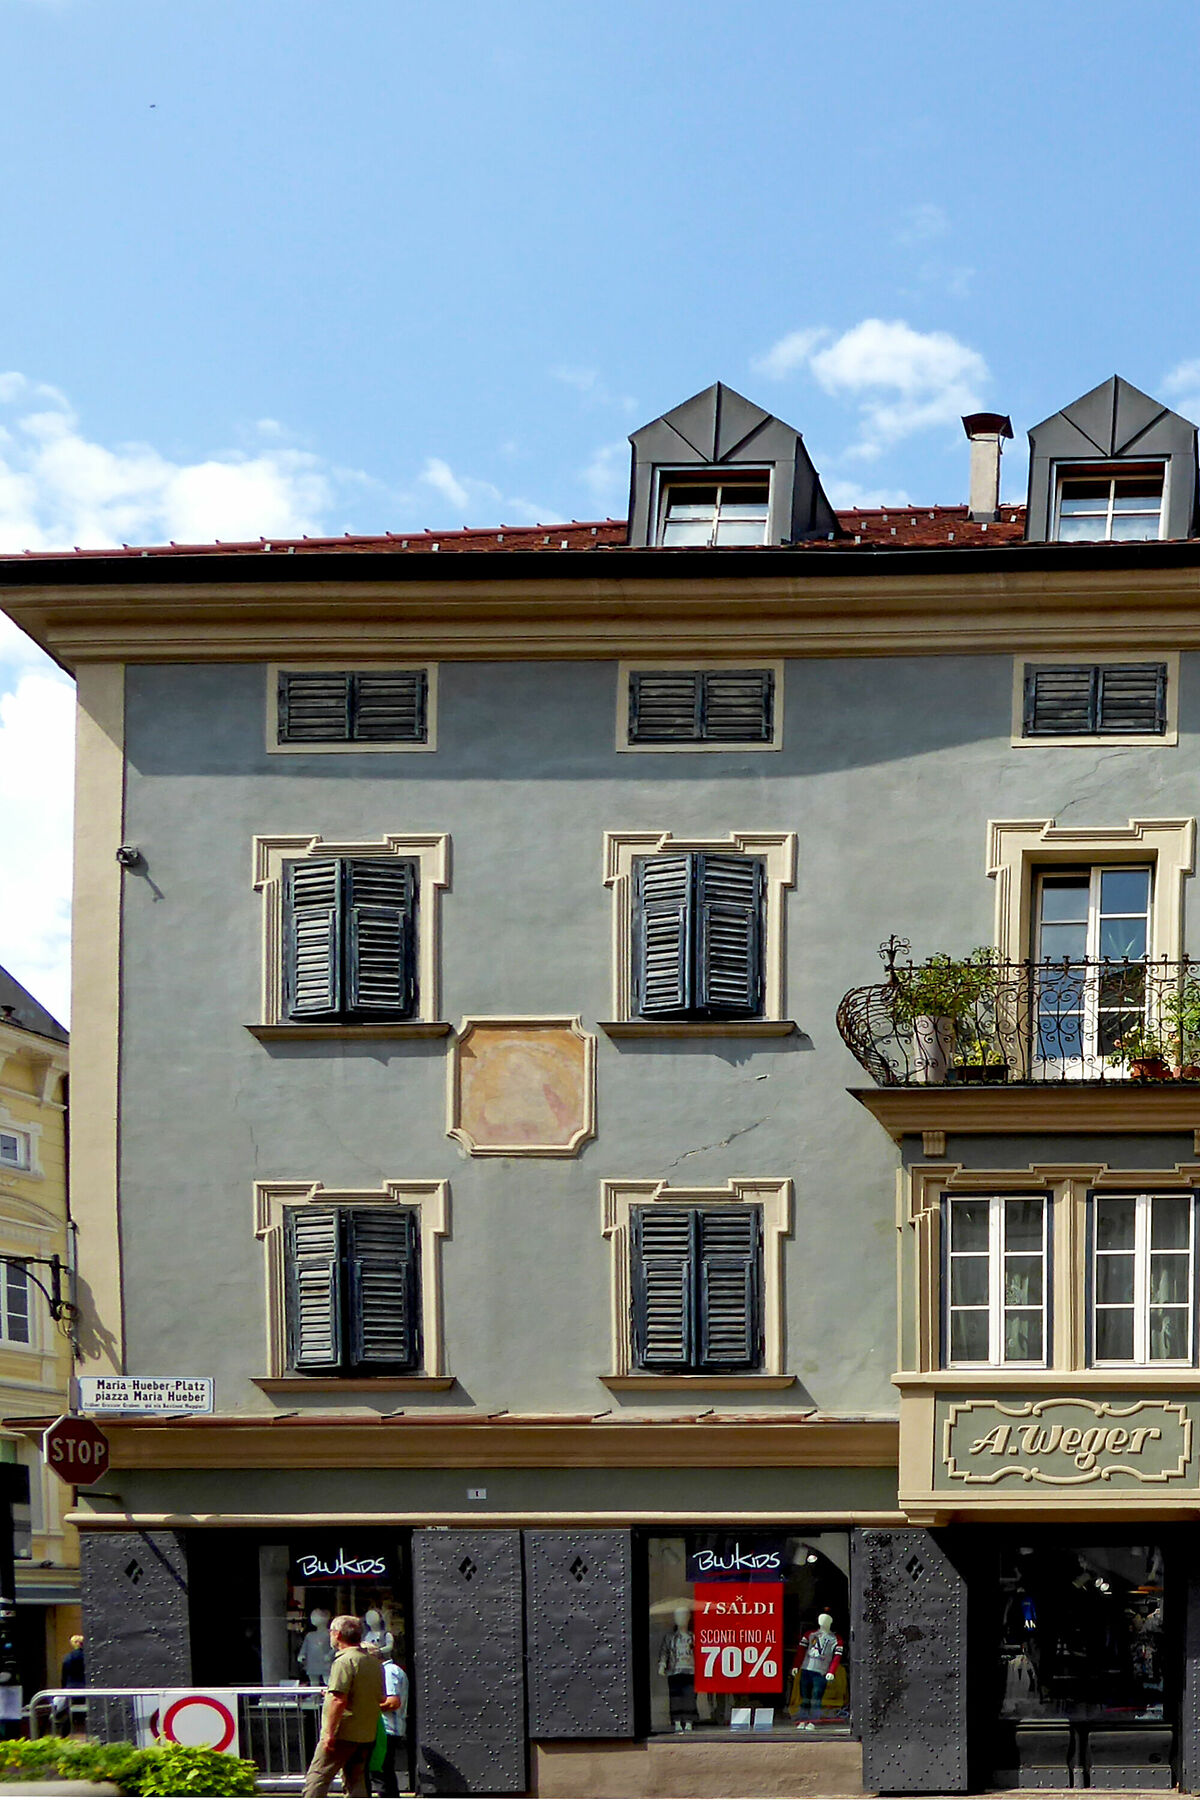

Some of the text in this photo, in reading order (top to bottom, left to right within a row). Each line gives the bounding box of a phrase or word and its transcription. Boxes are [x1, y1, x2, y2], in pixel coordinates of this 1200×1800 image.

[97, 1379, 205, 1391] Maria-Hueber-Platz
[95, 1391, 205, 1402] piazza Maria Hueber
[52, 1437, 106, 1465] STOP
[716, 1601, 775, 1615] SALDI
[700, 1629, 777, 1644] SCONTI FINO AL
[700, 1646, 778, 1678] 70%
